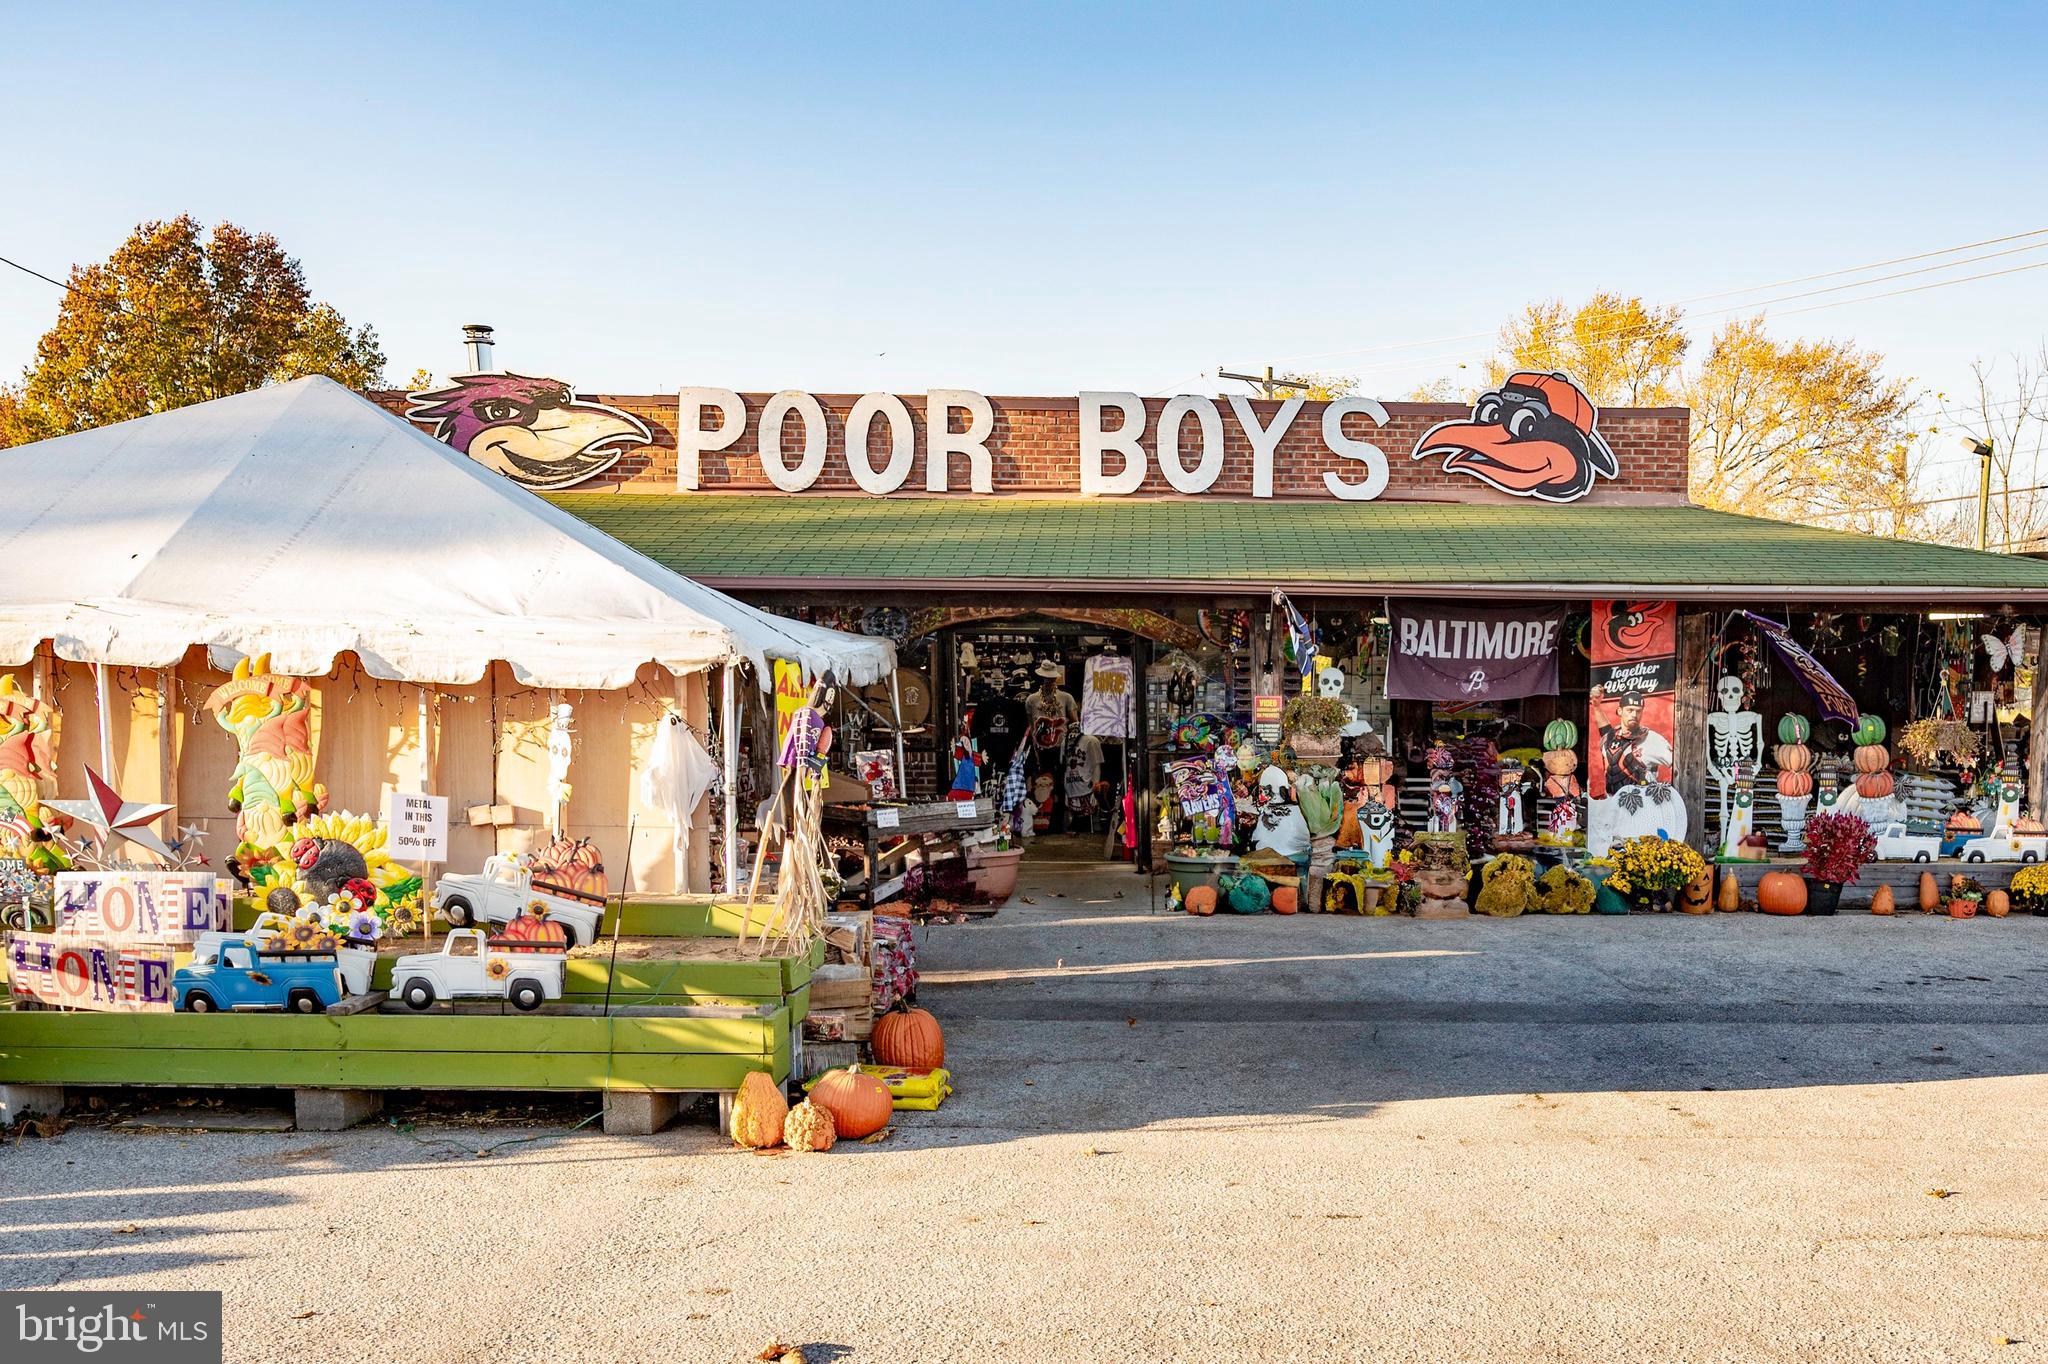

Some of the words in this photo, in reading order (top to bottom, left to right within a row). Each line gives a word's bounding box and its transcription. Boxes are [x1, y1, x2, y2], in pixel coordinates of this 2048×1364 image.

[677, 386, 994, 494] POOR
[1079, 391, 1390, 500] BOYS
[1400, 618, 1558, 660] BALTIMORE
[1611, 662, 1660, 682] Together
[217, 680, 267, 699] WELCOME
[1604, 680, 1626, 693] We
[1626, 676, 1659, 693] Play
[1259, 699, 1278, 707] VIDEO
[405, 798, 433, 809] METAL
[1181, 793, 1220, 817] RAVENS
[404, 811, 414, 821] IN
[415, 812, 433, 822] THIS
[412, 824, 426, 834] BIN
[398, 836, 421, 847] 50%
[422, 838, 437, 847] OFF
[61, 880, 210, 935] HOME
[10, 938, 168, 1004] HOME
